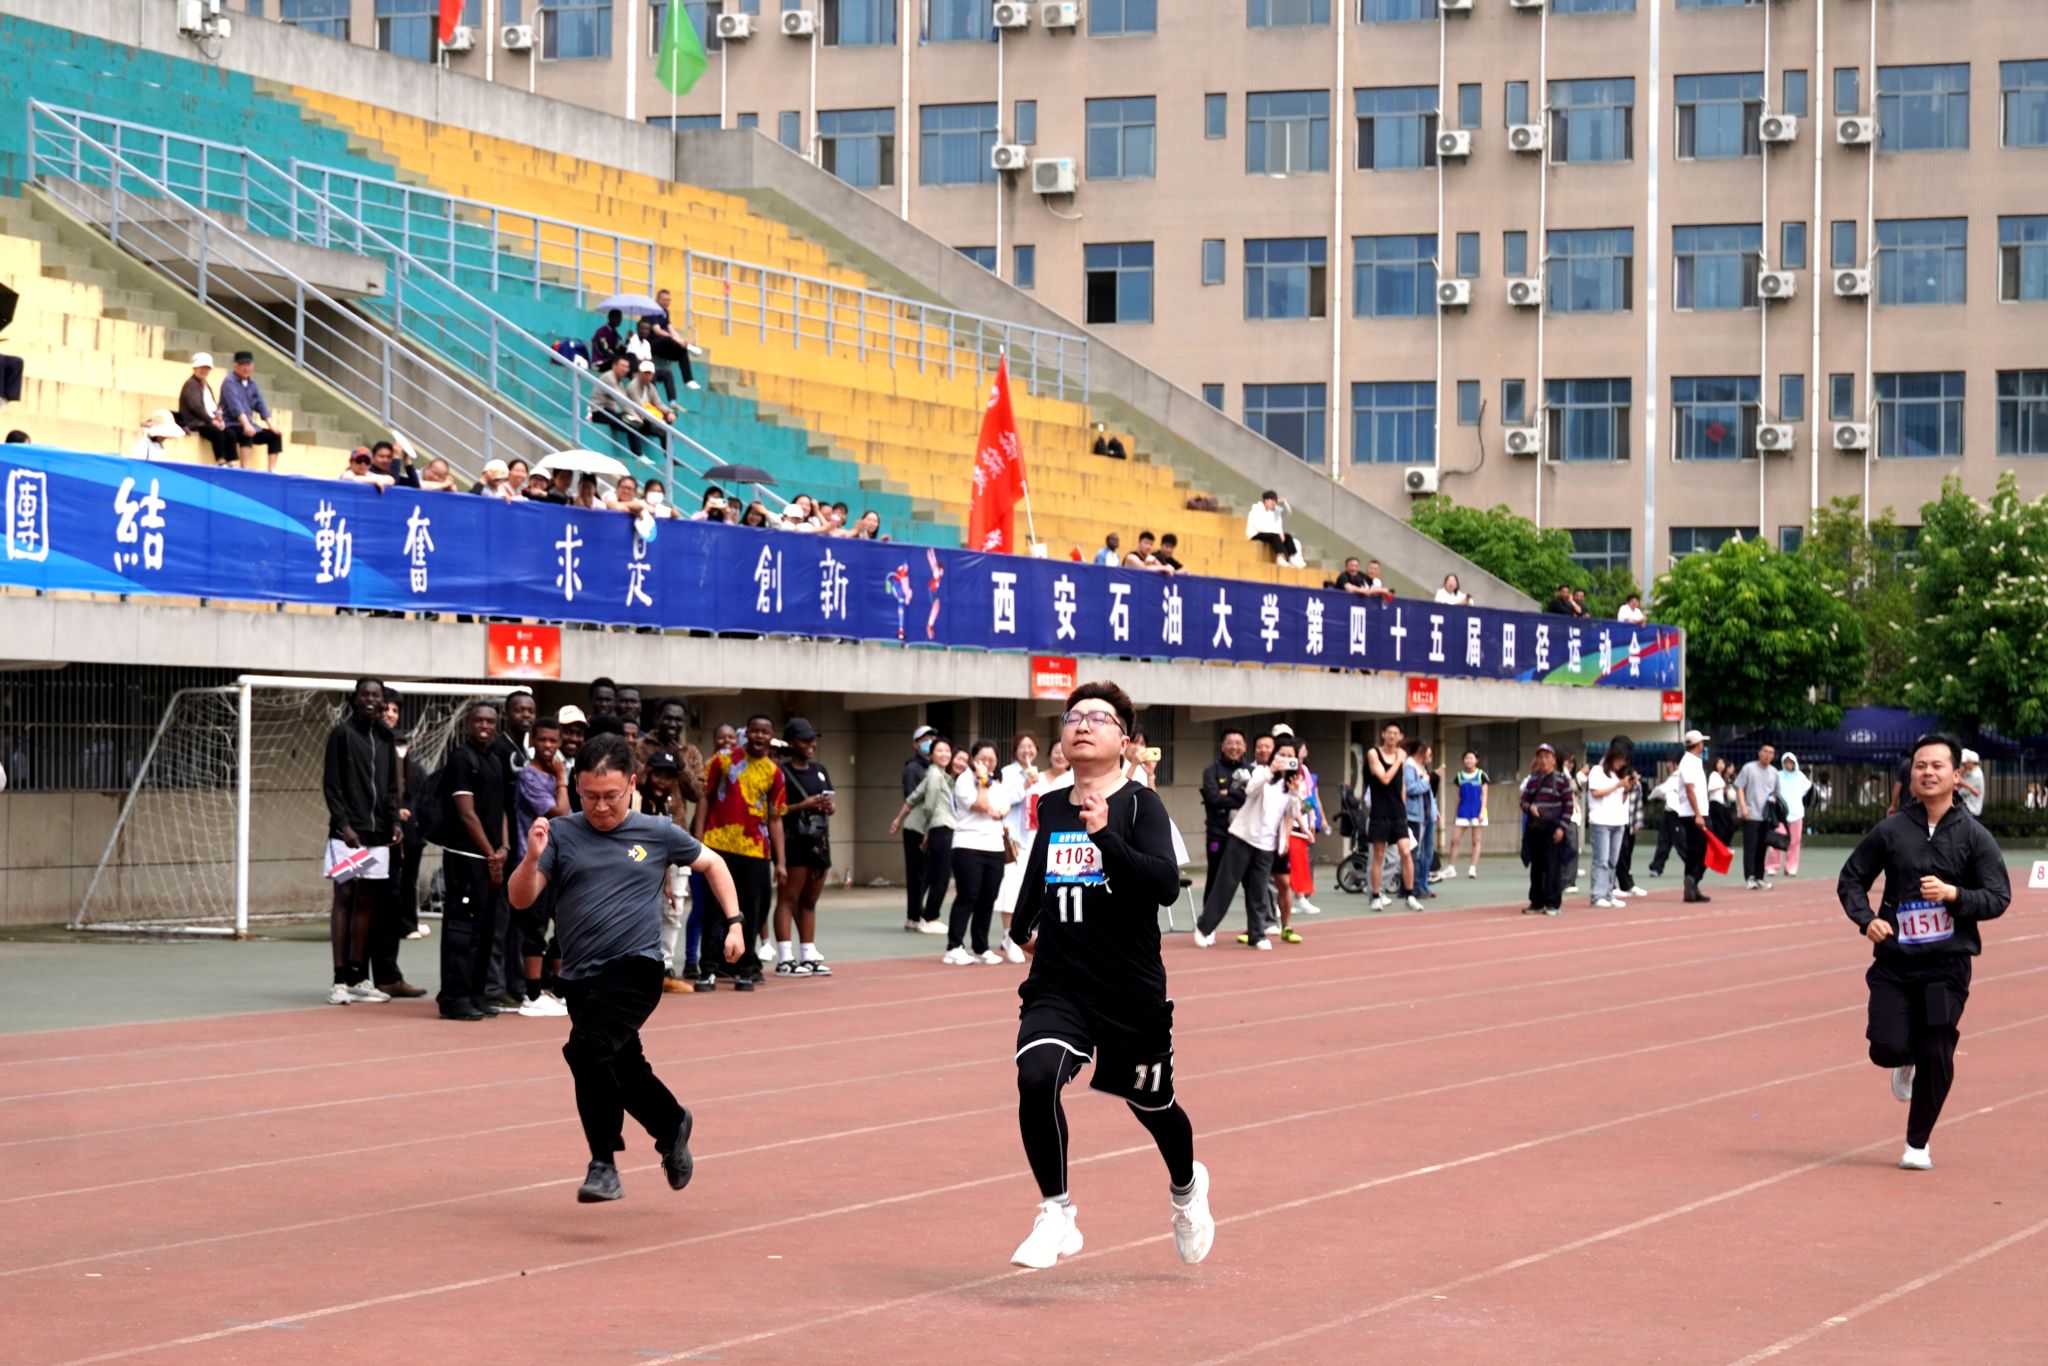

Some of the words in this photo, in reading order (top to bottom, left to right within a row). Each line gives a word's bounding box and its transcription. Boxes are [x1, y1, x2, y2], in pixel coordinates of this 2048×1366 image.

[991, 571, 1641, 678] 西安石油大学第四十五届田径运动会
[1055, 847, 1095, 865] t103
[2037, 865, 2045, 880] 8
[1056, 886, 1083, 923] 11
[1902, 911, 1951, 936] t1512
[1133, 1062, 1163, 1093] 11
